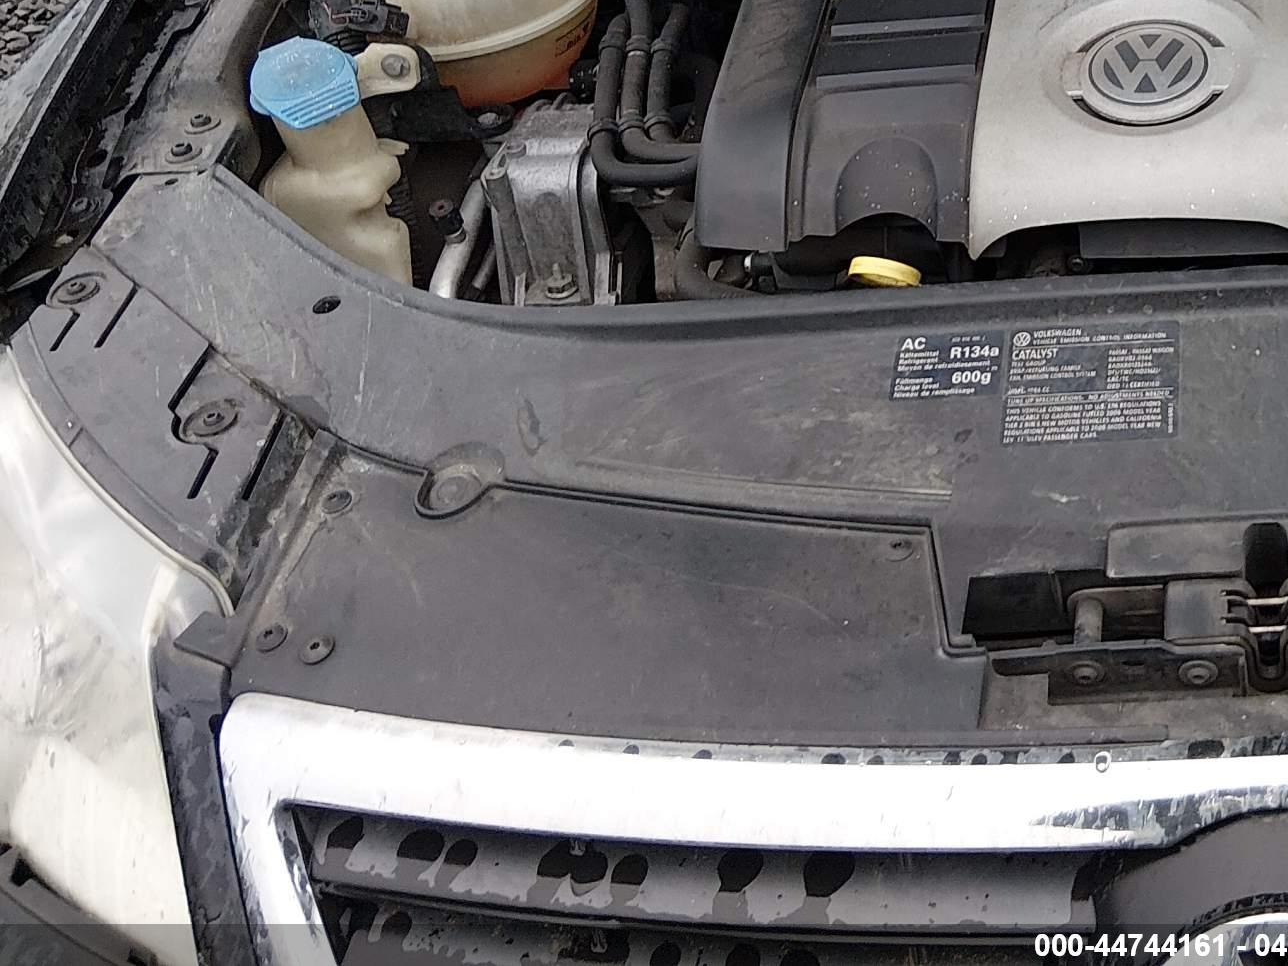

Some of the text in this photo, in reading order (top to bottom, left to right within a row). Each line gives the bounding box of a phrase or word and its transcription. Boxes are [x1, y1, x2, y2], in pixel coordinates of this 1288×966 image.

[1033, 328, 1082, 338] VOLKSWAGEN
[1123, 332, 1167, 340] INFORMATION
[901, 337, 927, 351] AC
[950, 345, 999, 359] R134a
[1012, 348, 1058, 360] CATALYST
[899, 357, 939, 365] Refrigerant
[897, 363, 922, 372] Moyen
[952, 370, 992, 385] 600g
[921, 382, 939, 390] level
